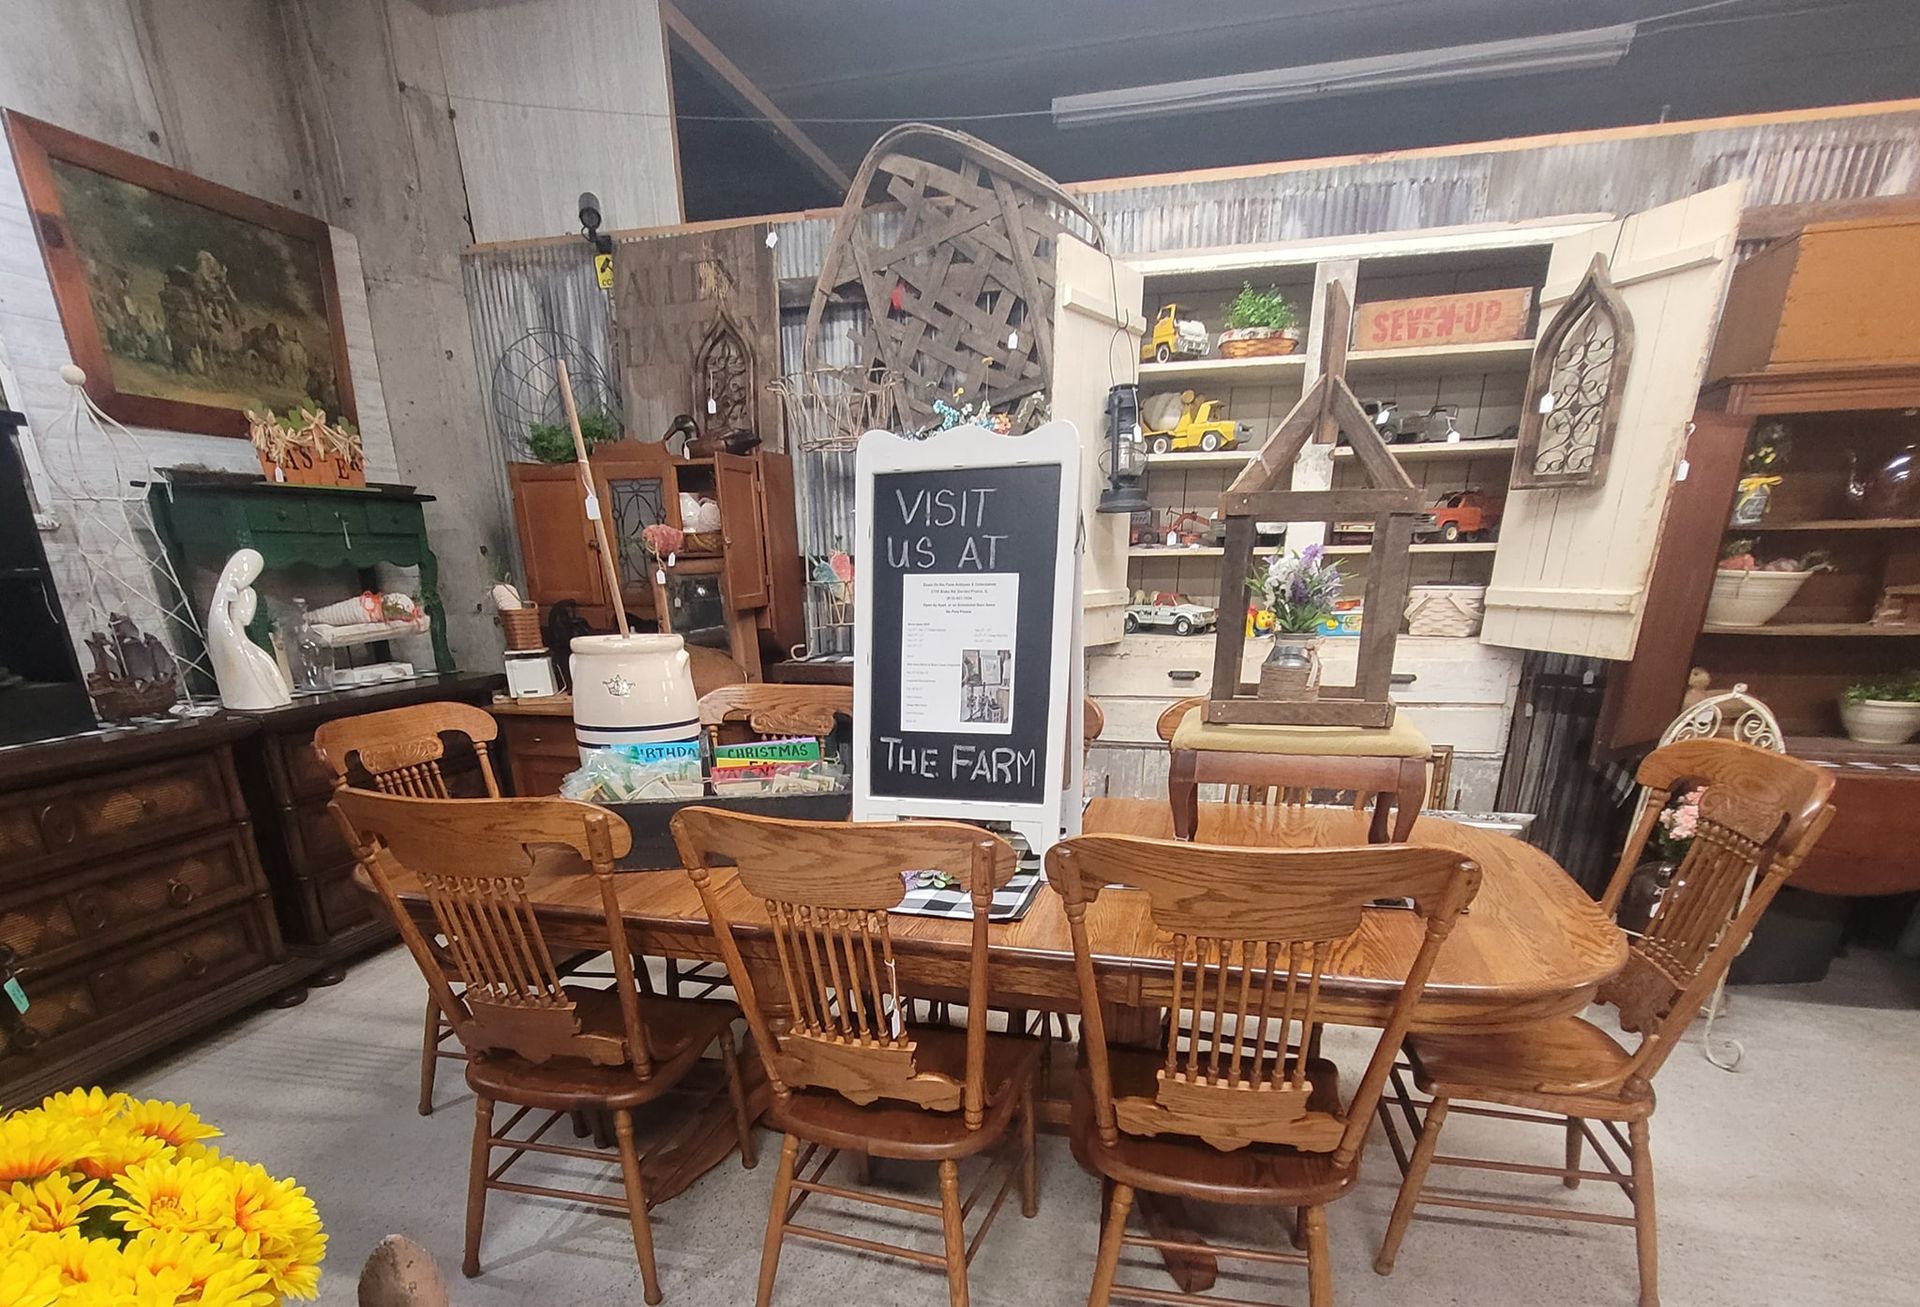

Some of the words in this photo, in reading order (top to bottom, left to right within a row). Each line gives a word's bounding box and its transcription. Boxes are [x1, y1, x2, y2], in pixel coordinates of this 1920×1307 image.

[1374, 301, 1501, 343] SEVEN-UP
[896, 489, 998, 527] VISIT
[887, 536, 936, 568] US
[957, 534, 1009, 570] AT
[639, 746, 698, 758] IRTHDA
[727, 743, 809, 759] CHRISTMAS
[880, 736, 939, 778] THE
[951, 744, 1036, 787] FARM
